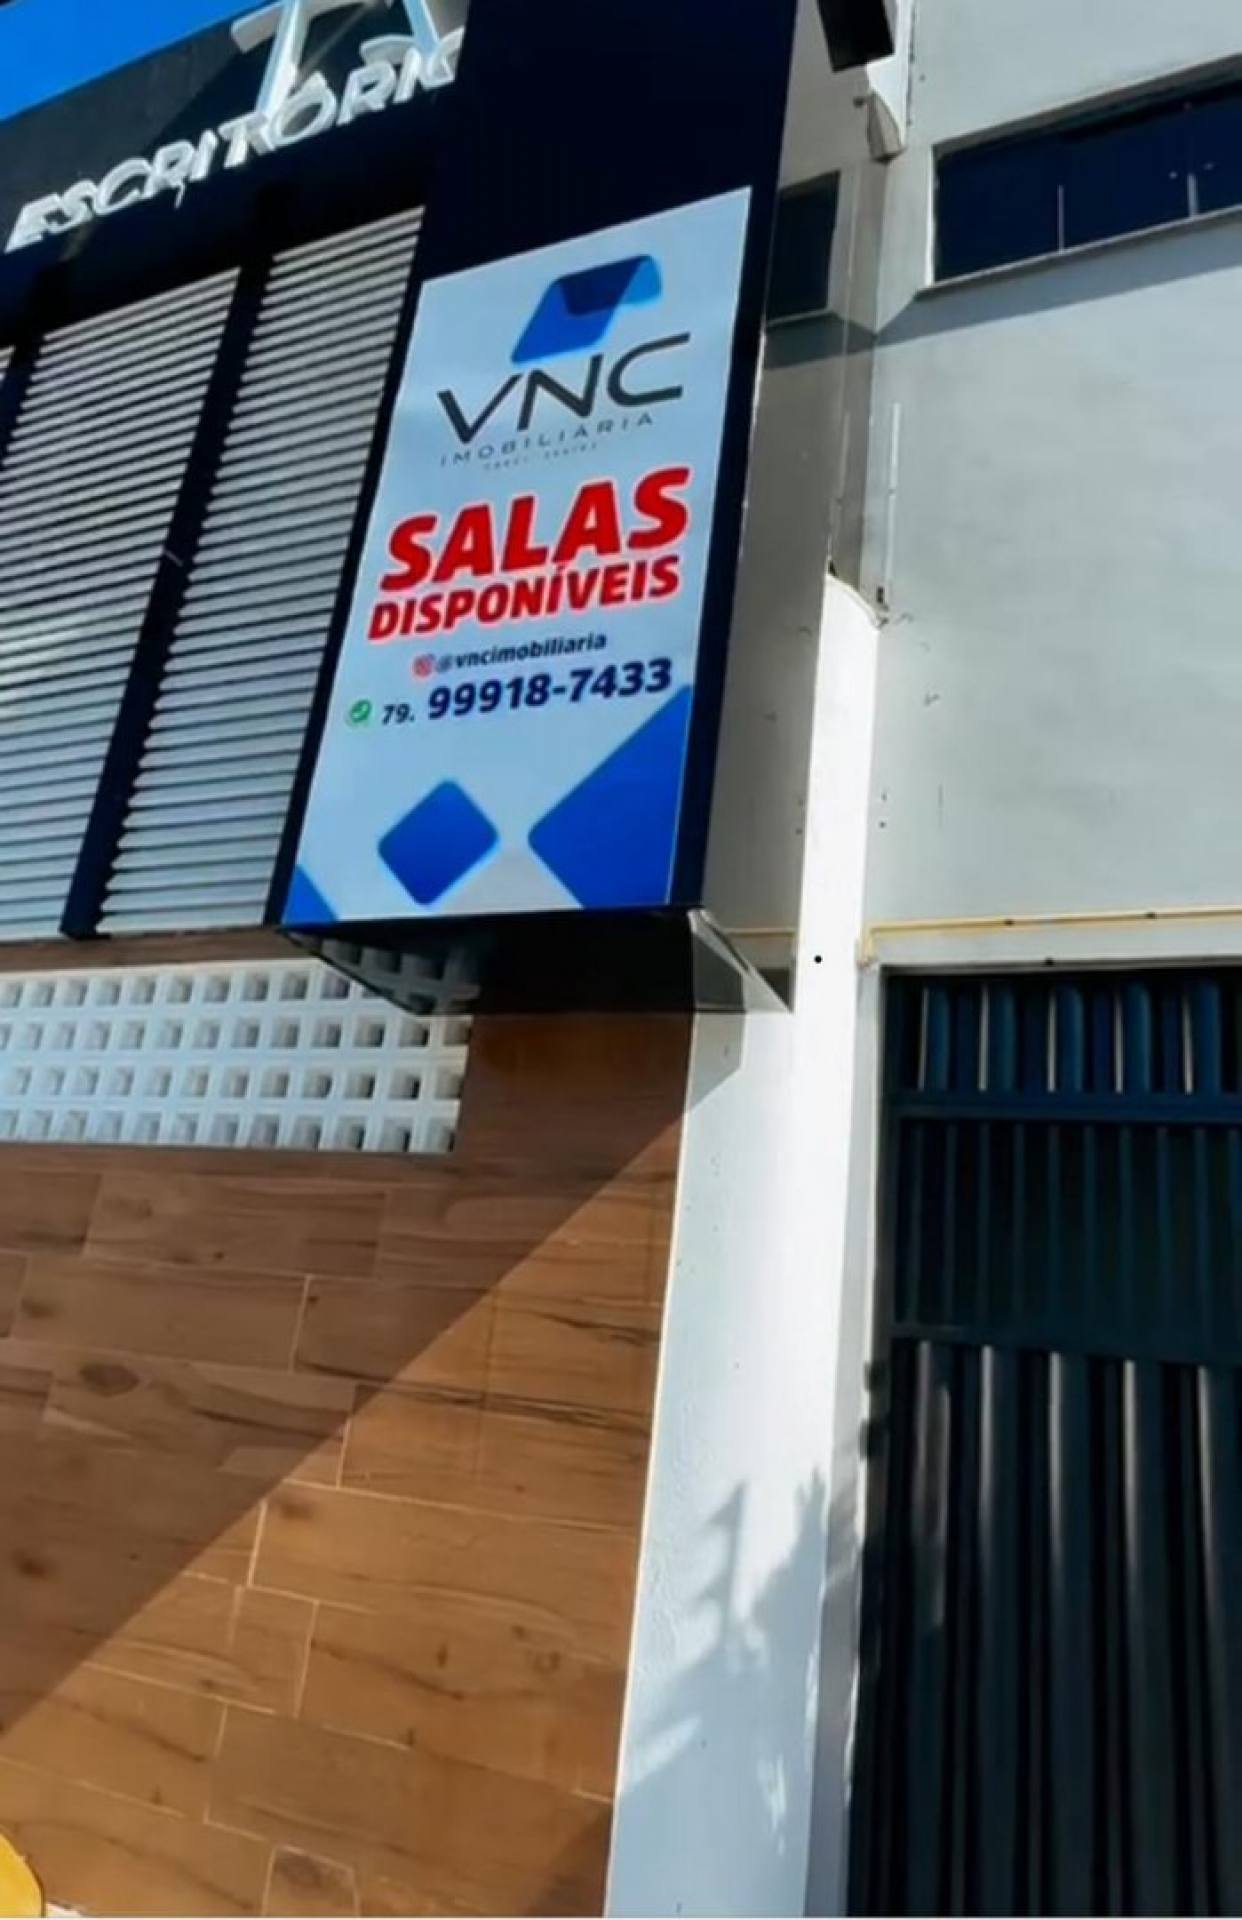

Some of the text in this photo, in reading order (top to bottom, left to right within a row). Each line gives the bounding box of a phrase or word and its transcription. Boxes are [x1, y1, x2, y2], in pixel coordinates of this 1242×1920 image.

[437, 332, 691, 443] VNC
[380, 467, 690, 591] SALAS
[368, 555, 680, 640] DISPONÍVEIS
[381, 657, 672, 726] 79. 99918-7433
[436, 633, 607, 674] @vncimobiliaria
